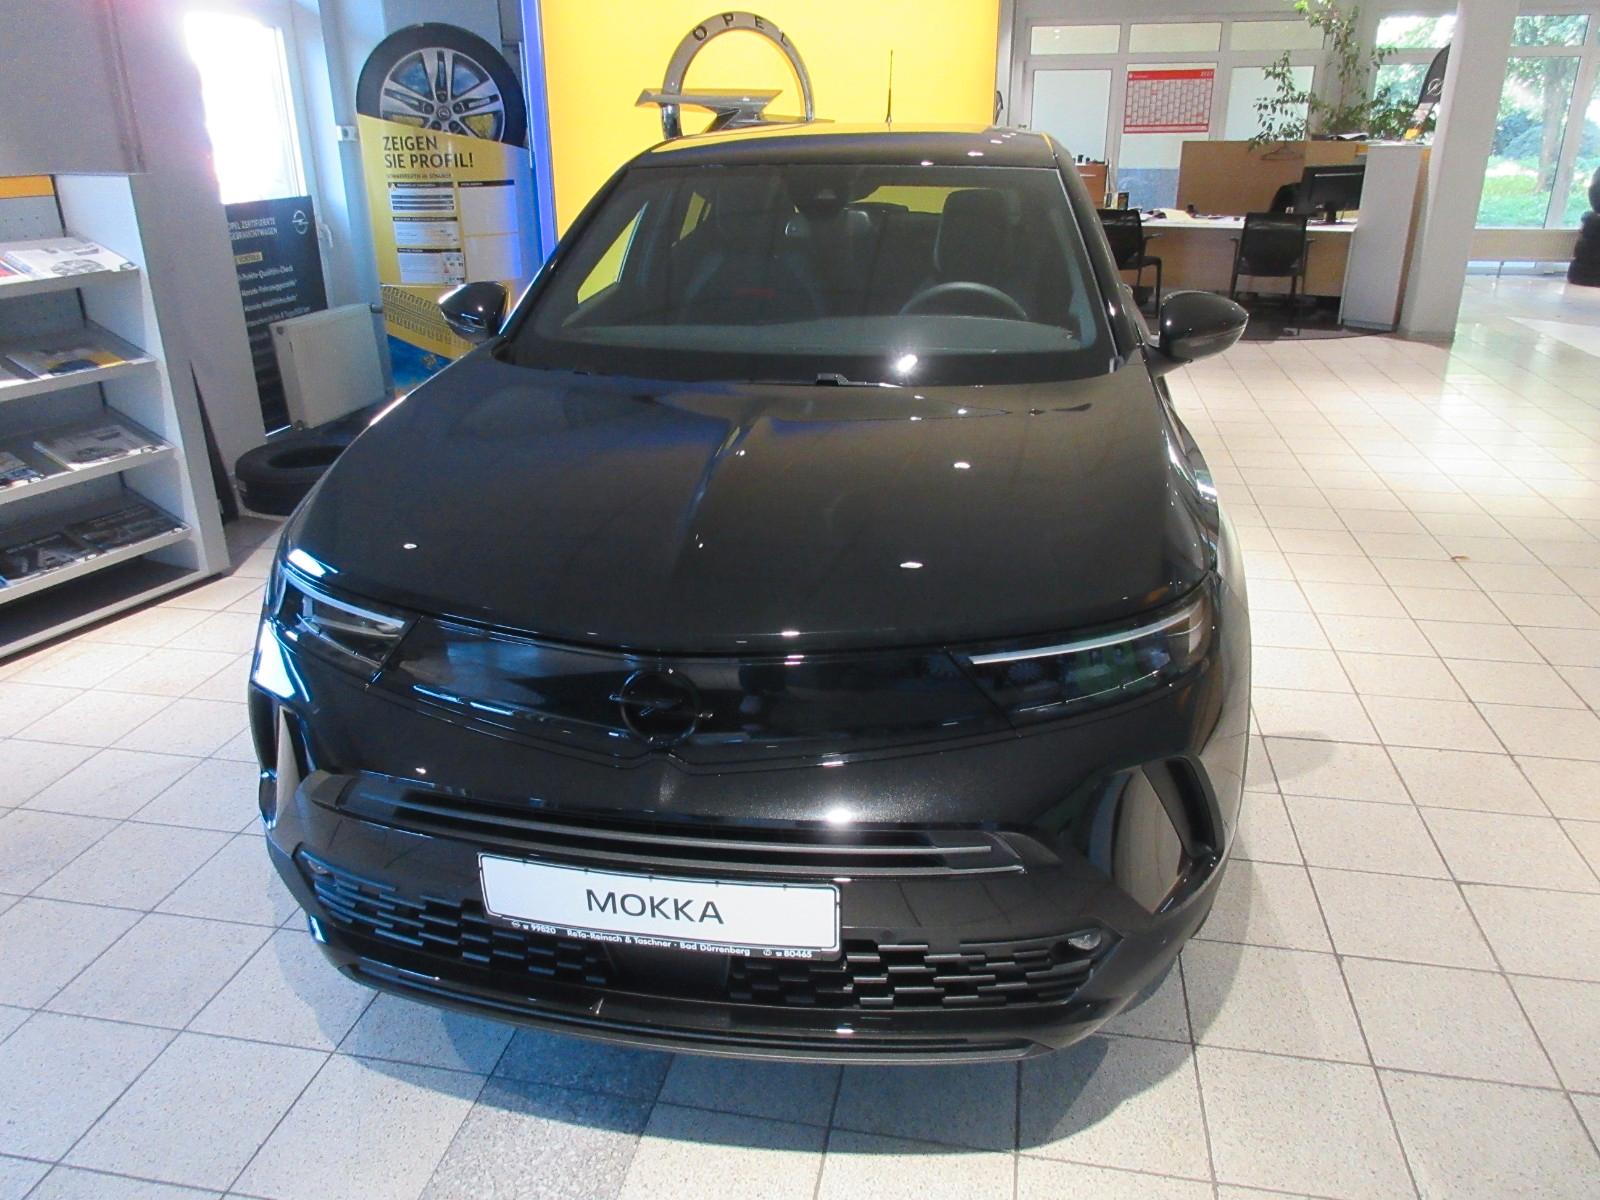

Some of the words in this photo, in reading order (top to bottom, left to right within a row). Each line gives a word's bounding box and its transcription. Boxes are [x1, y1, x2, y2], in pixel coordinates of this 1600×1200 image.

[692, 12, 790, 48] OPEL
[383, 135, 439, 151] ZEIGEN
[384, 153, 406, 169] SIE
[410, 152, 474, 169] PROFIL!
[585, 888, 724, 925] MOKKA
[625, 934, 632, 943] &
[634, 936, 672, 948] Taschner
[680, 941, 697, 951] Bad
[700, 943, 750, 957] Dürrenberg
